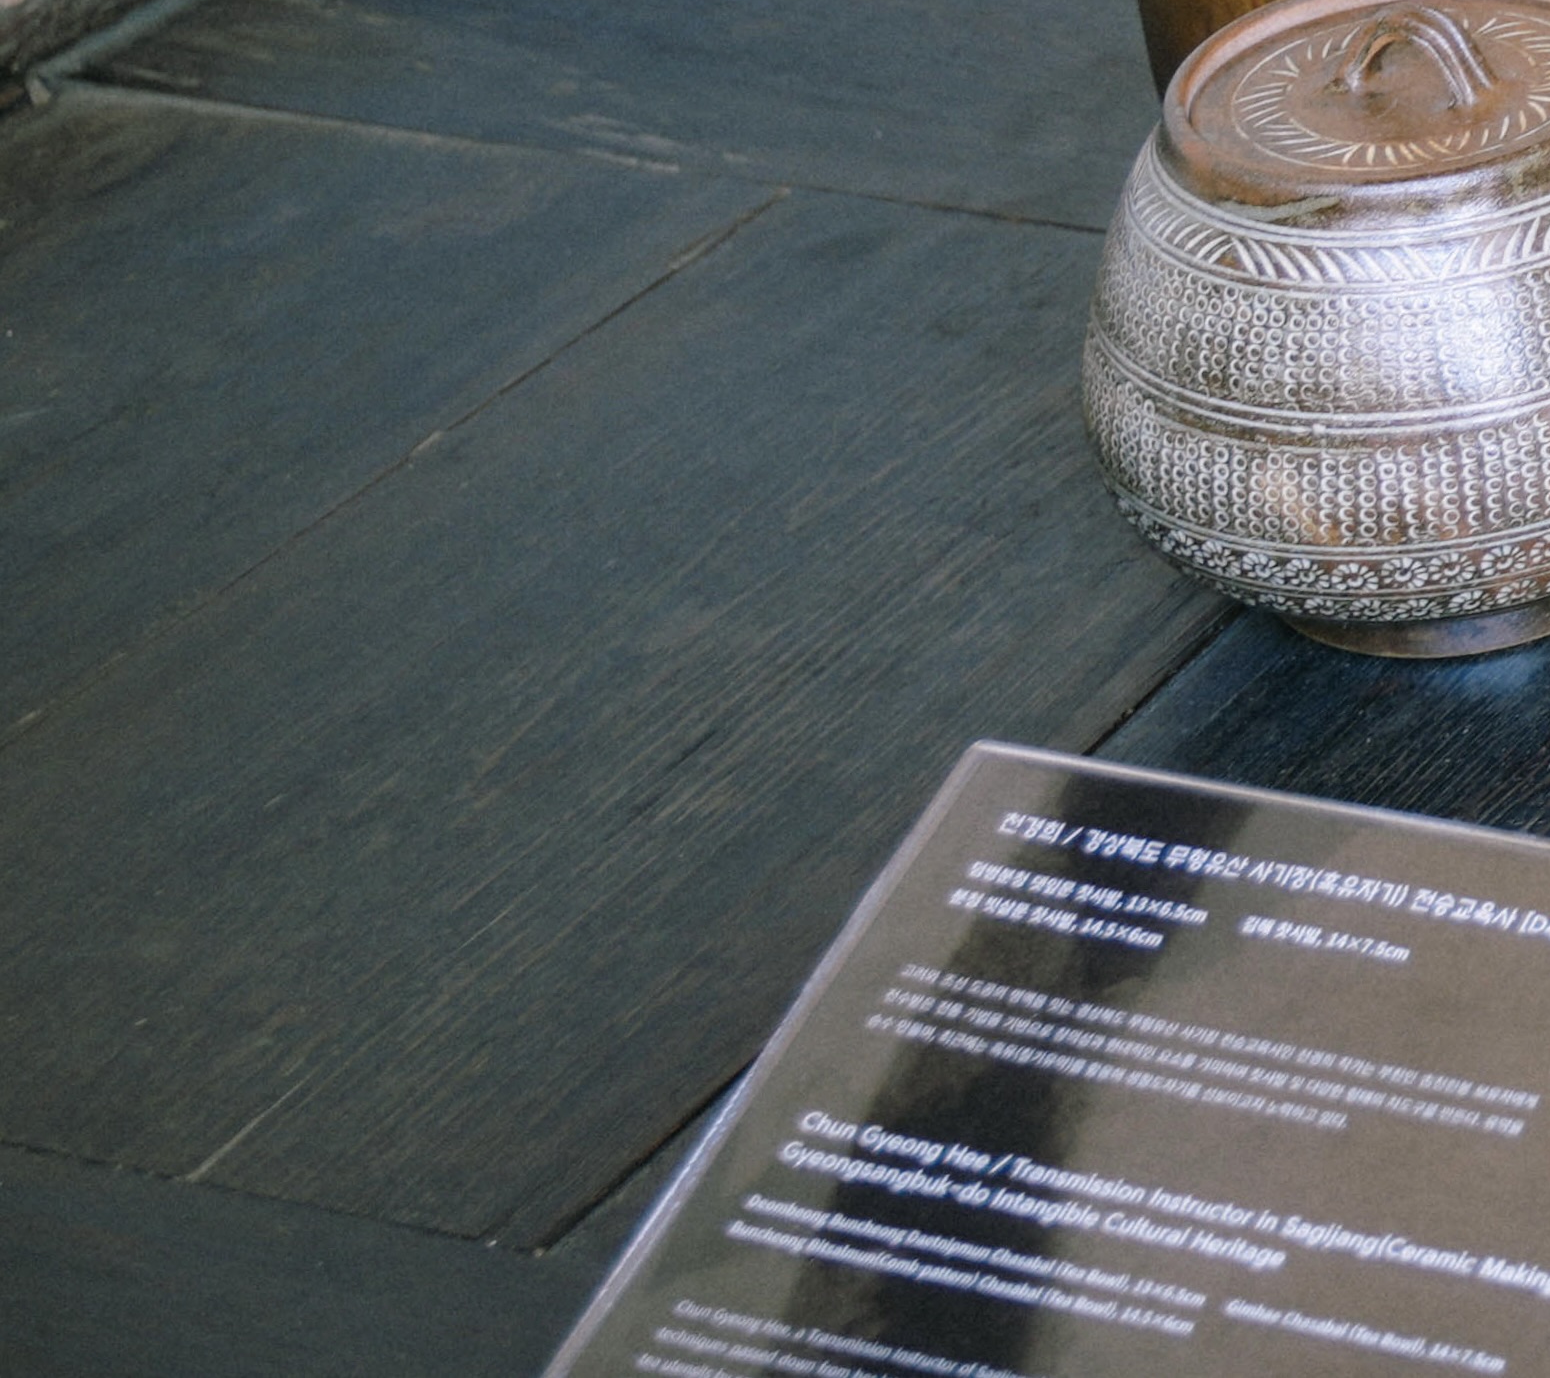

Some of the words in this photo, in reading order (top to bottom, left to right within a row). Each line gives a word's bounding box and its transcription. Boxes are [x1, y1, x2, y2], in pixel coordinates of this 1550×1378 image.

[998, 813, 1066, 844] 천경희
[1061, 827, 1083, 845] /
[1084, 829, 1165, 863] 경상북도
[1164, 845, 1248, 877] 무형유산
[1410, 889, 1518, 929] 전승교육사
[781, 1141, 990, 1205] Gyeongsangbuk-do
[989, 1188, 1099, 1227] Intangible
[1101, 1212, 1192, 1246] Cultural
[1189, 1231, 1286, 1270] Heritage
[799, 1111, 858, 1140] Chun
[860, 1126, 944, 1165] Gyeong
[943, 1144, 990, 1171] Hee
[988, 1154, 1013, 1174] /
[1010, 1157, 1145, 1202] Transmission
[1147, 1188, 1254, 1226] Instructor
[1254, 1210, 1279, 1232] in
[1280, 1216, 1477, 1274] Sagijang(Ceramic
